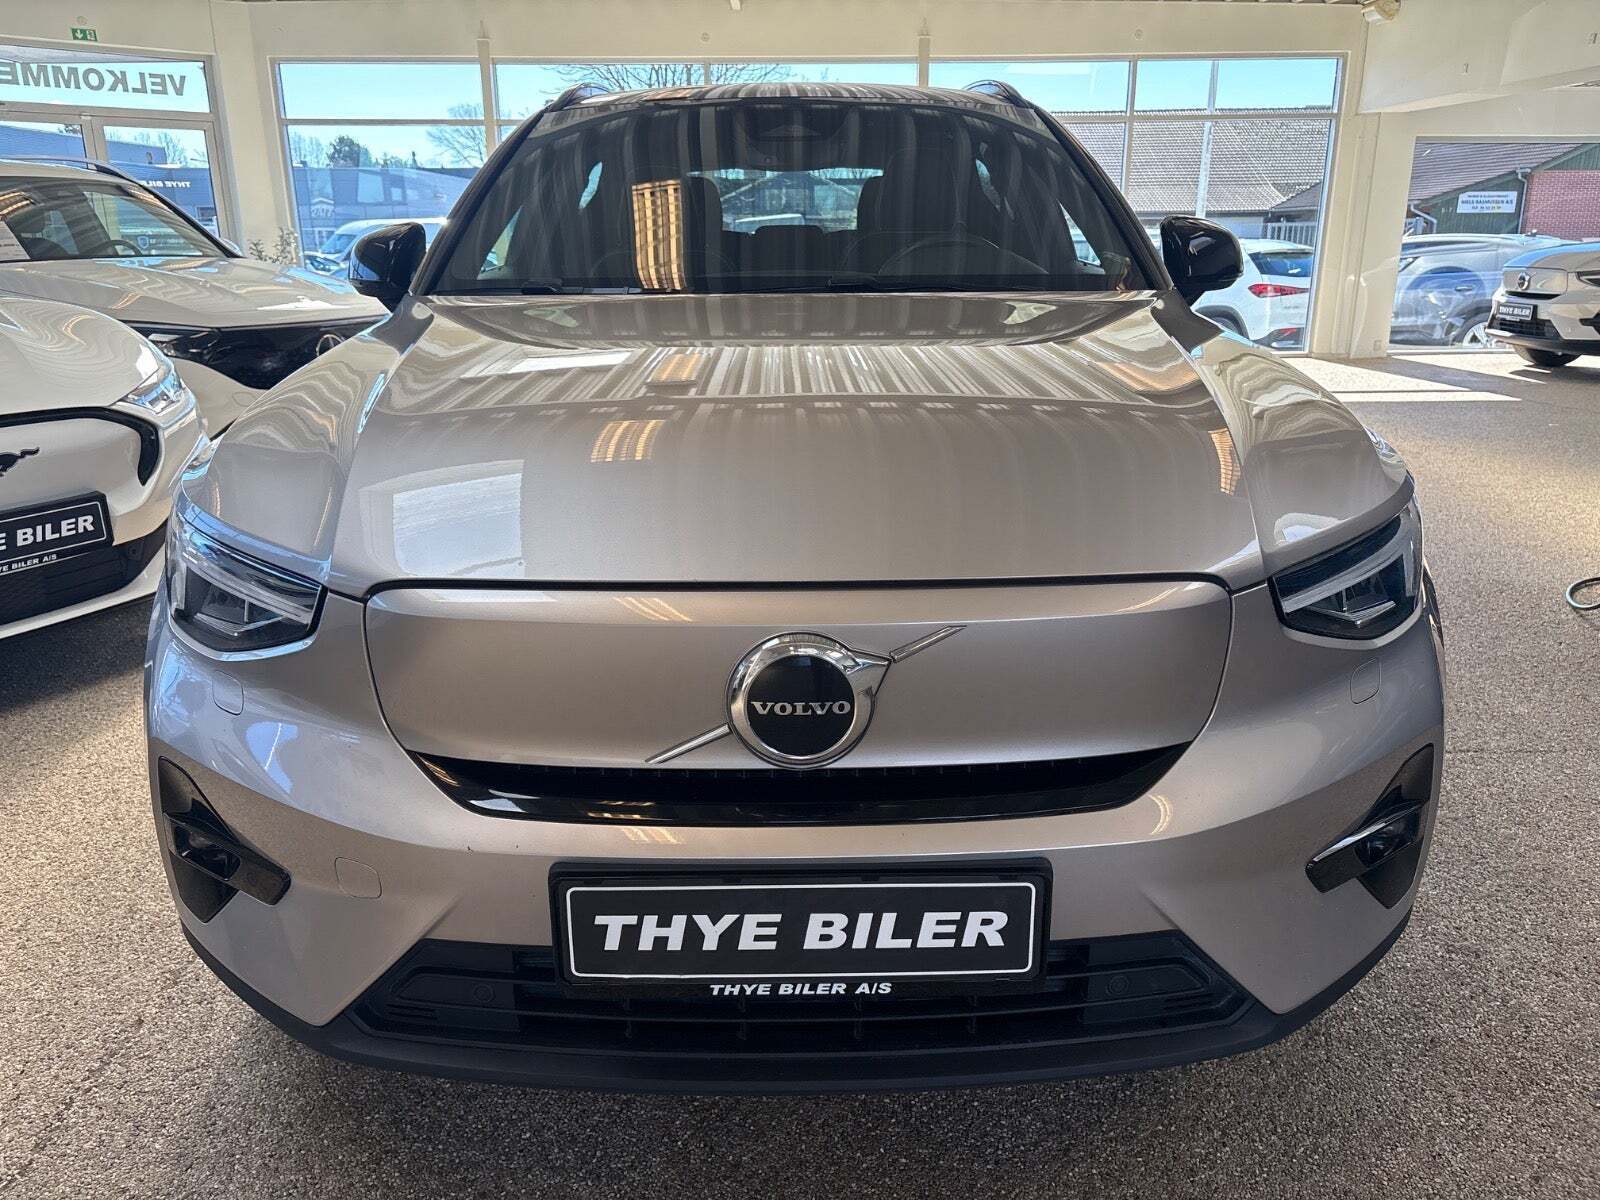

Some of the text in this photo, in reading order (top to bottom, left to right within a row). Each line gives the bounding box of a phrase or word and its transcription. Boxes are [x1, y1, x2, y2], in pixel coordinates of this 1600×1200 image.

[16, 514, 95, 547] BILER
[11, 558, 39, 570] BILER
[42, 553, 57, 563] A/S
[750, 700, 851, 716] VOLVO
[594, 911, 1009, 951] THYE BILER
[710, 983, 892, 996] THYE BILER A/S
